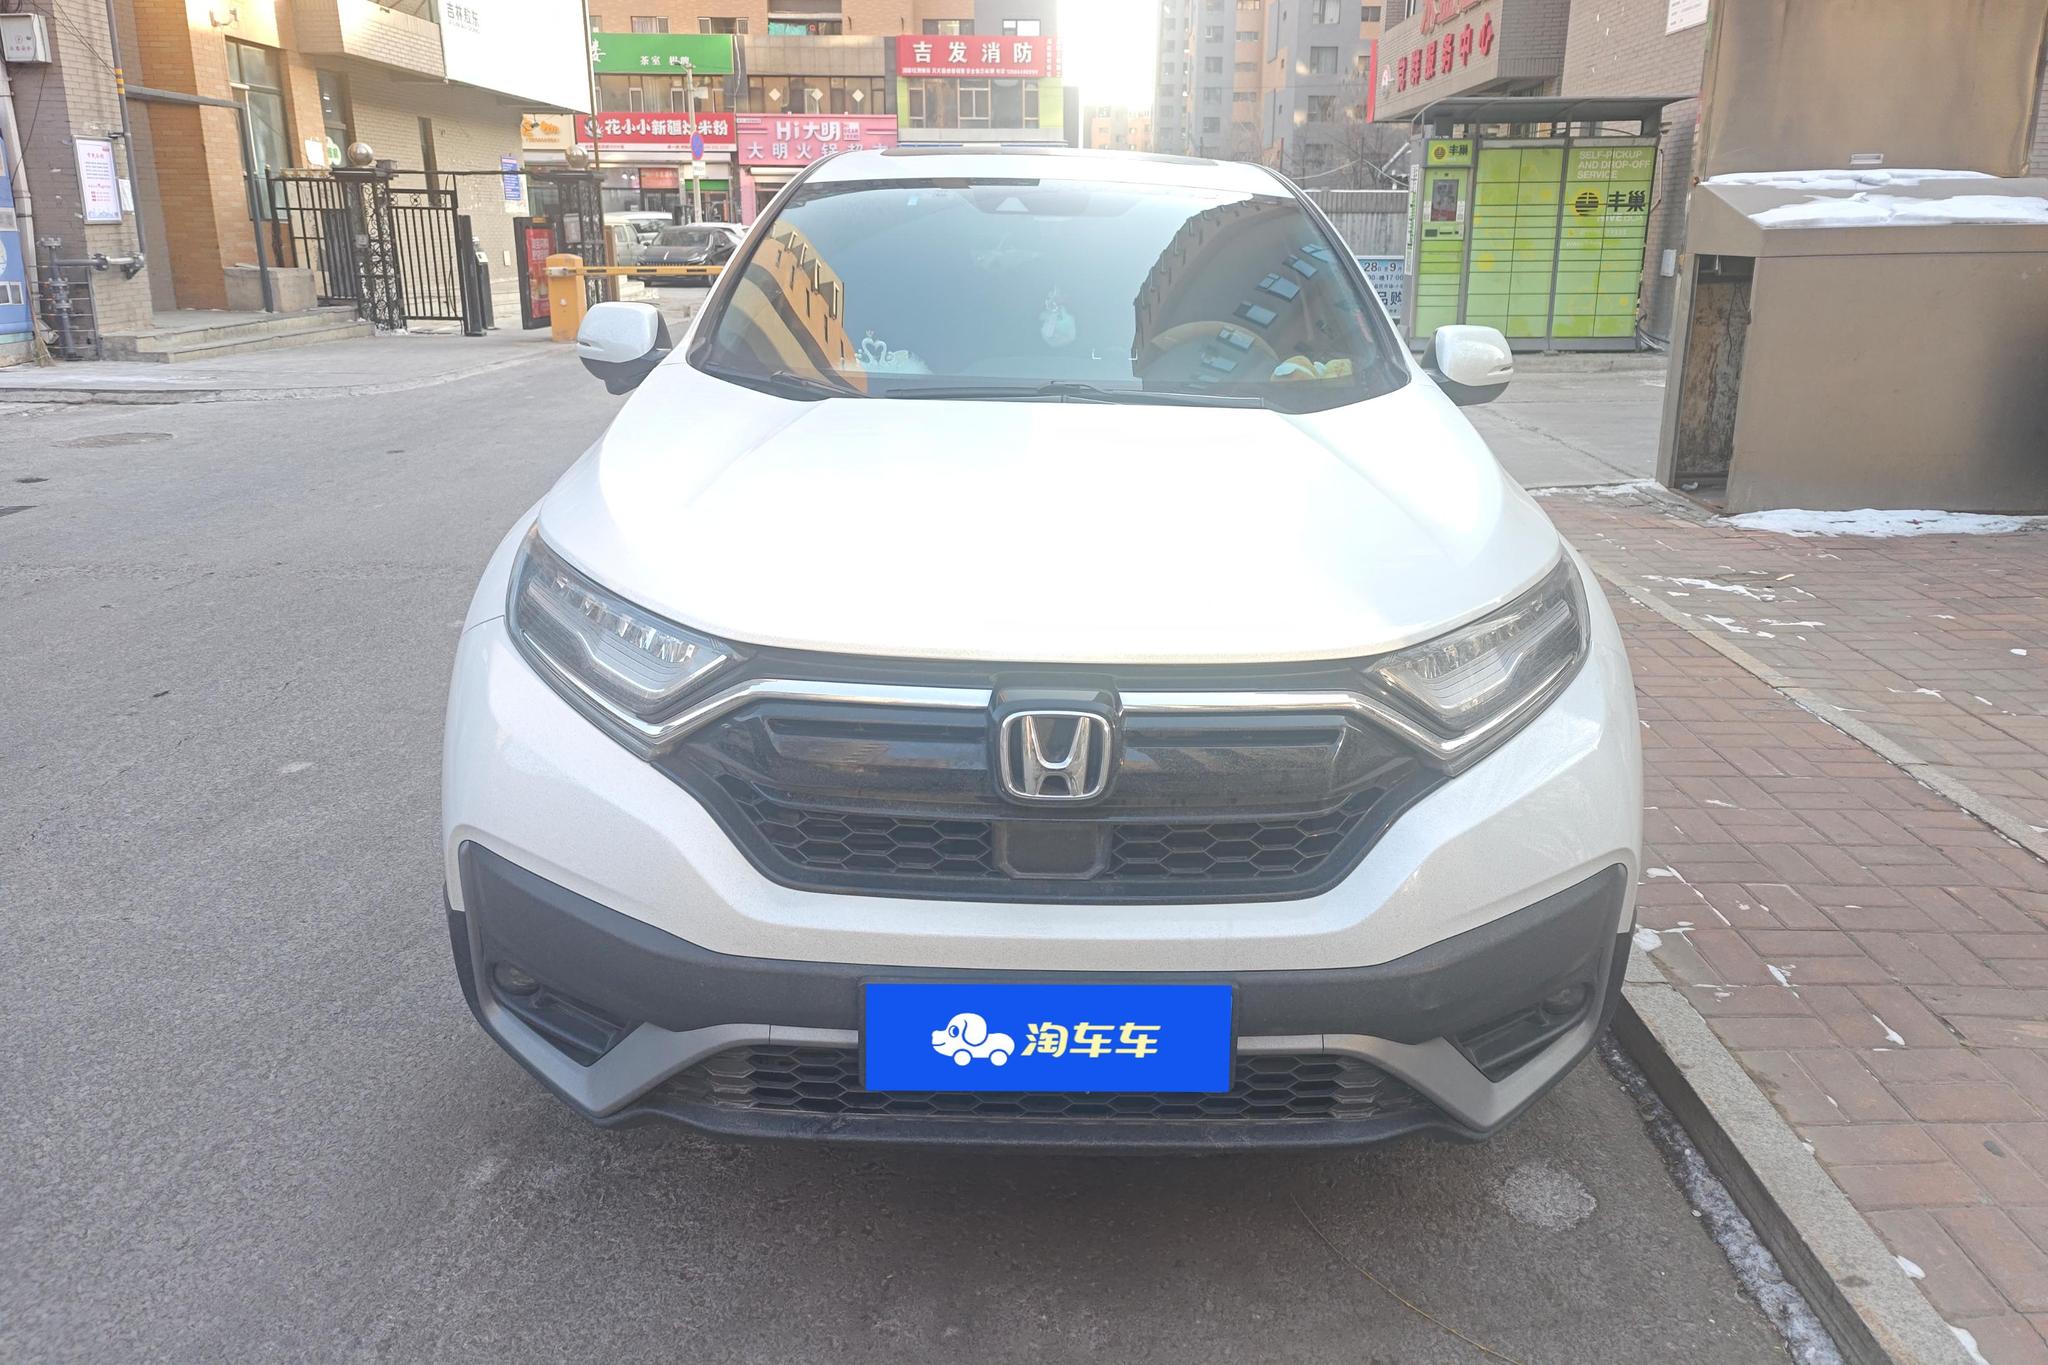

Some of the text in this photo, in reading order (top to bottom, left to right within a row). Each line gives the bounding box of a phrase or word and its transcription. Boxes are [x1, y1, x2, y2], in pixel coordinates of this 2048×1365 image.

[913, 41, 1032, 63] 吉发消防
[1397, 12, 1494, 93] 党群服务中心
[605, 118, 728, 136] 花小小新疆炒米粉
[776, 121, 841, 141] Hi大明
[1449, 144, 1468, 155] 丰巢
[1580, 150, 1643, 160] SELF-PICKUP
[1578, 160, 1652, 170] AND DROP-OFF
[1577, 170, 1618, 179] SERVICE
[1608, 190, 1646, 212] 丰巢
